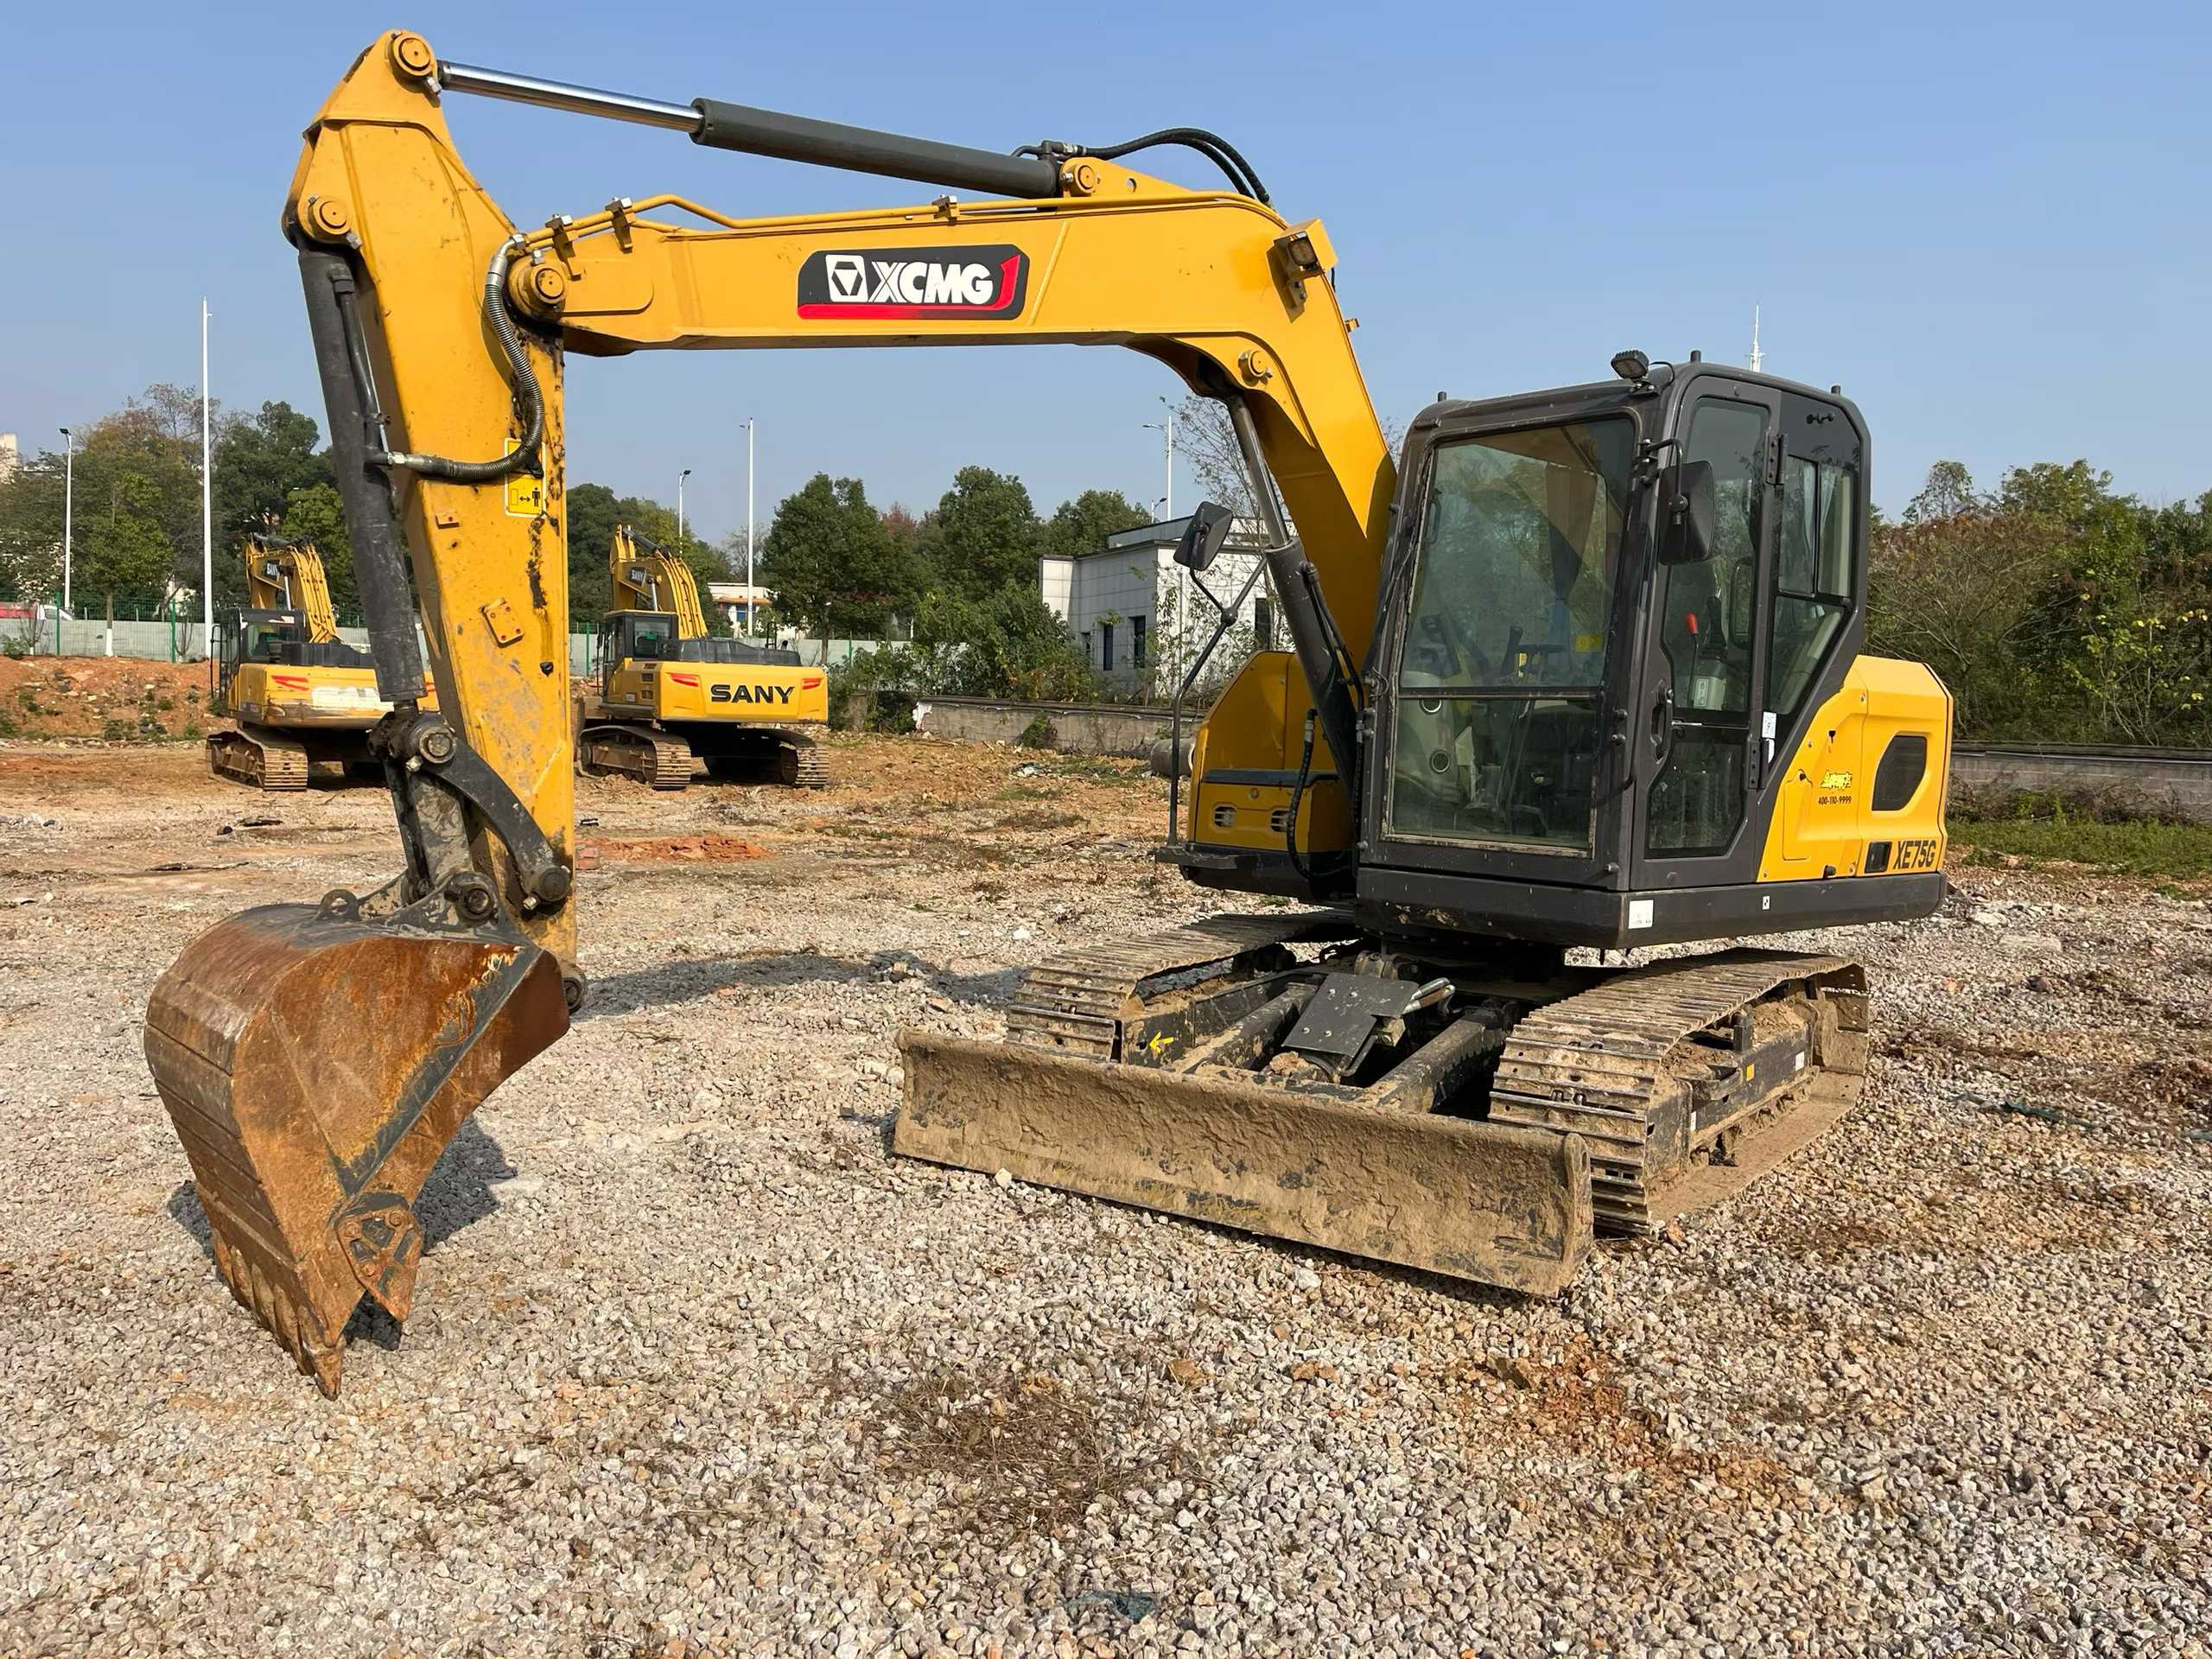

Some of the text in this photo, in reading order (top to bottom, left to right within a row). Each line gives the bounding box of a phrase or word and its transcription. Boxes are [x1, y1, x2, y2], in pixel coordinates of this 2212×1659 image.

[868, 261, 993, 304] XCMG
[710, 684, 796, 704] SANY
[1893, 840, 1936, 868] XE75G
